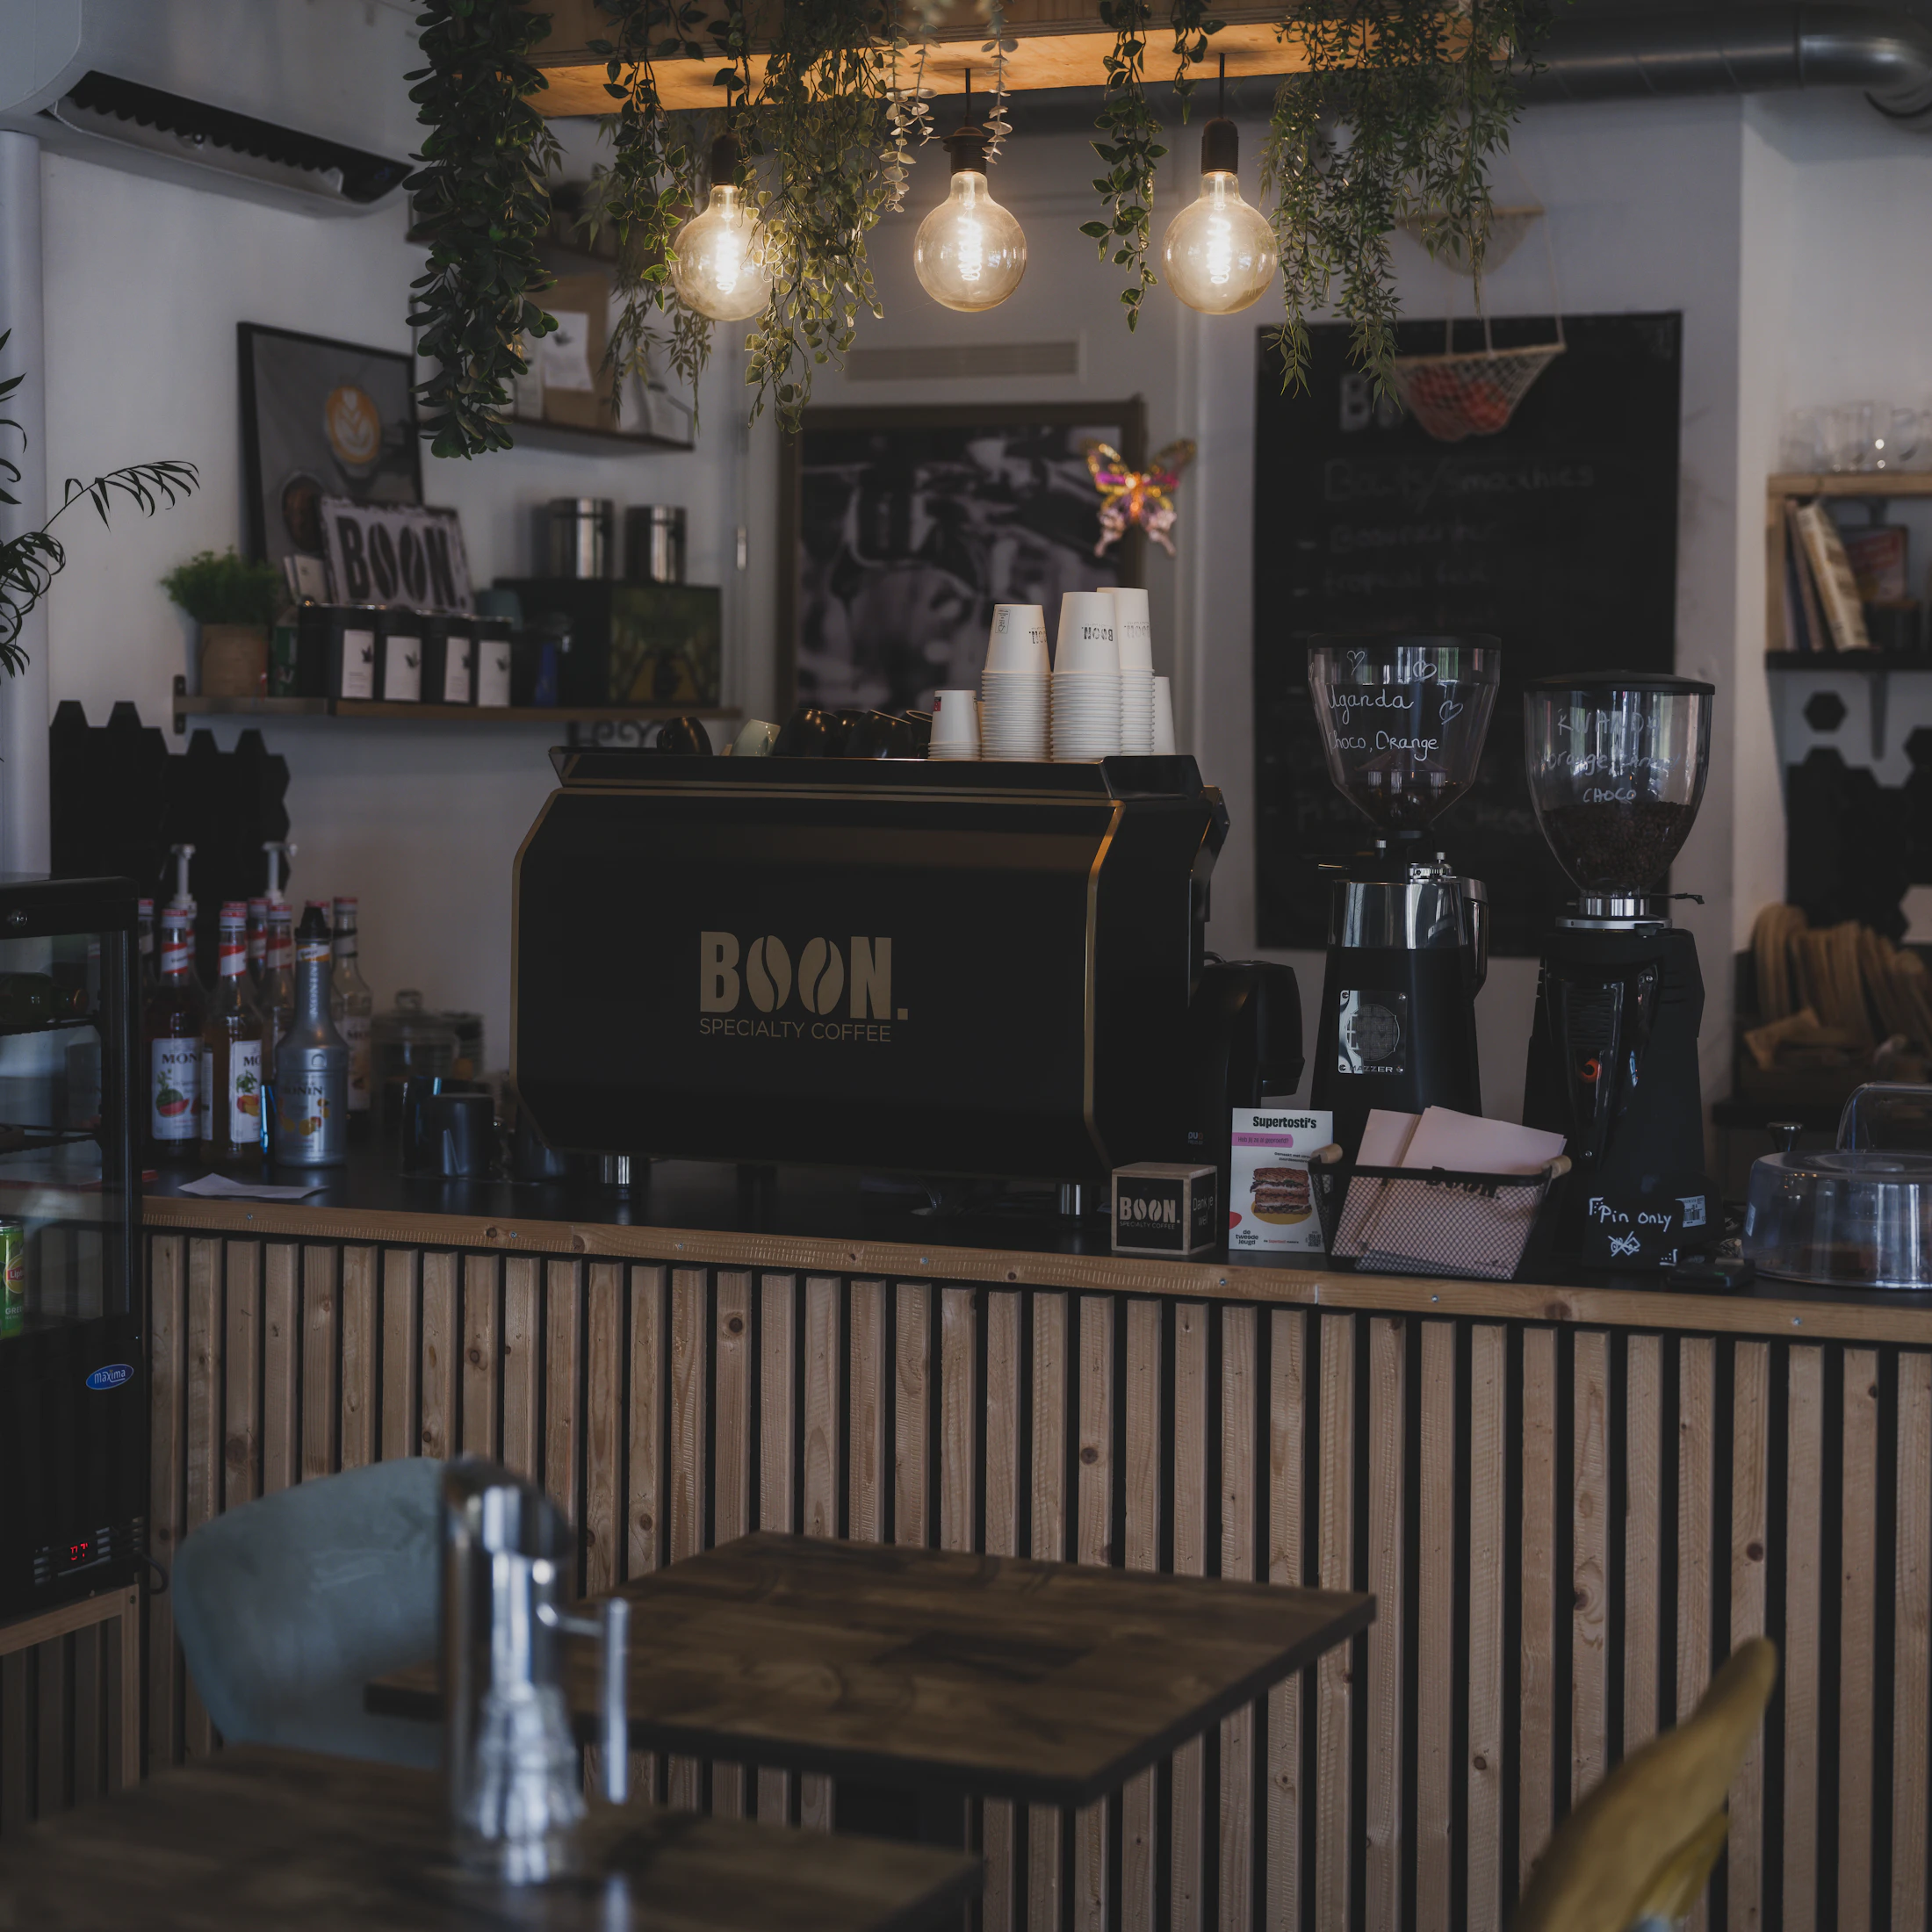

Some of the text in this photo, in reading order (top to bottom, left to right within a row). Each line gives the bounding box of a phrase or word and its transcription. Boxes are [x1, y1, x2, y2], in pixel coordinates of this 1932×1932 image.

[1325, 683, 1415, 725] Uganda
[1583, 789, 1637, 804] CHOCO
[700, 931, 909, 1020] BOON.
[700, 1019, 892, 1043] SPECIALTY COFFEE
[1253, 1116, 1316, 1128] Supertosti's
[1119, 1196, 1181, 1224] BOON.
[1598, 1204, 1629, 1224] Pin
